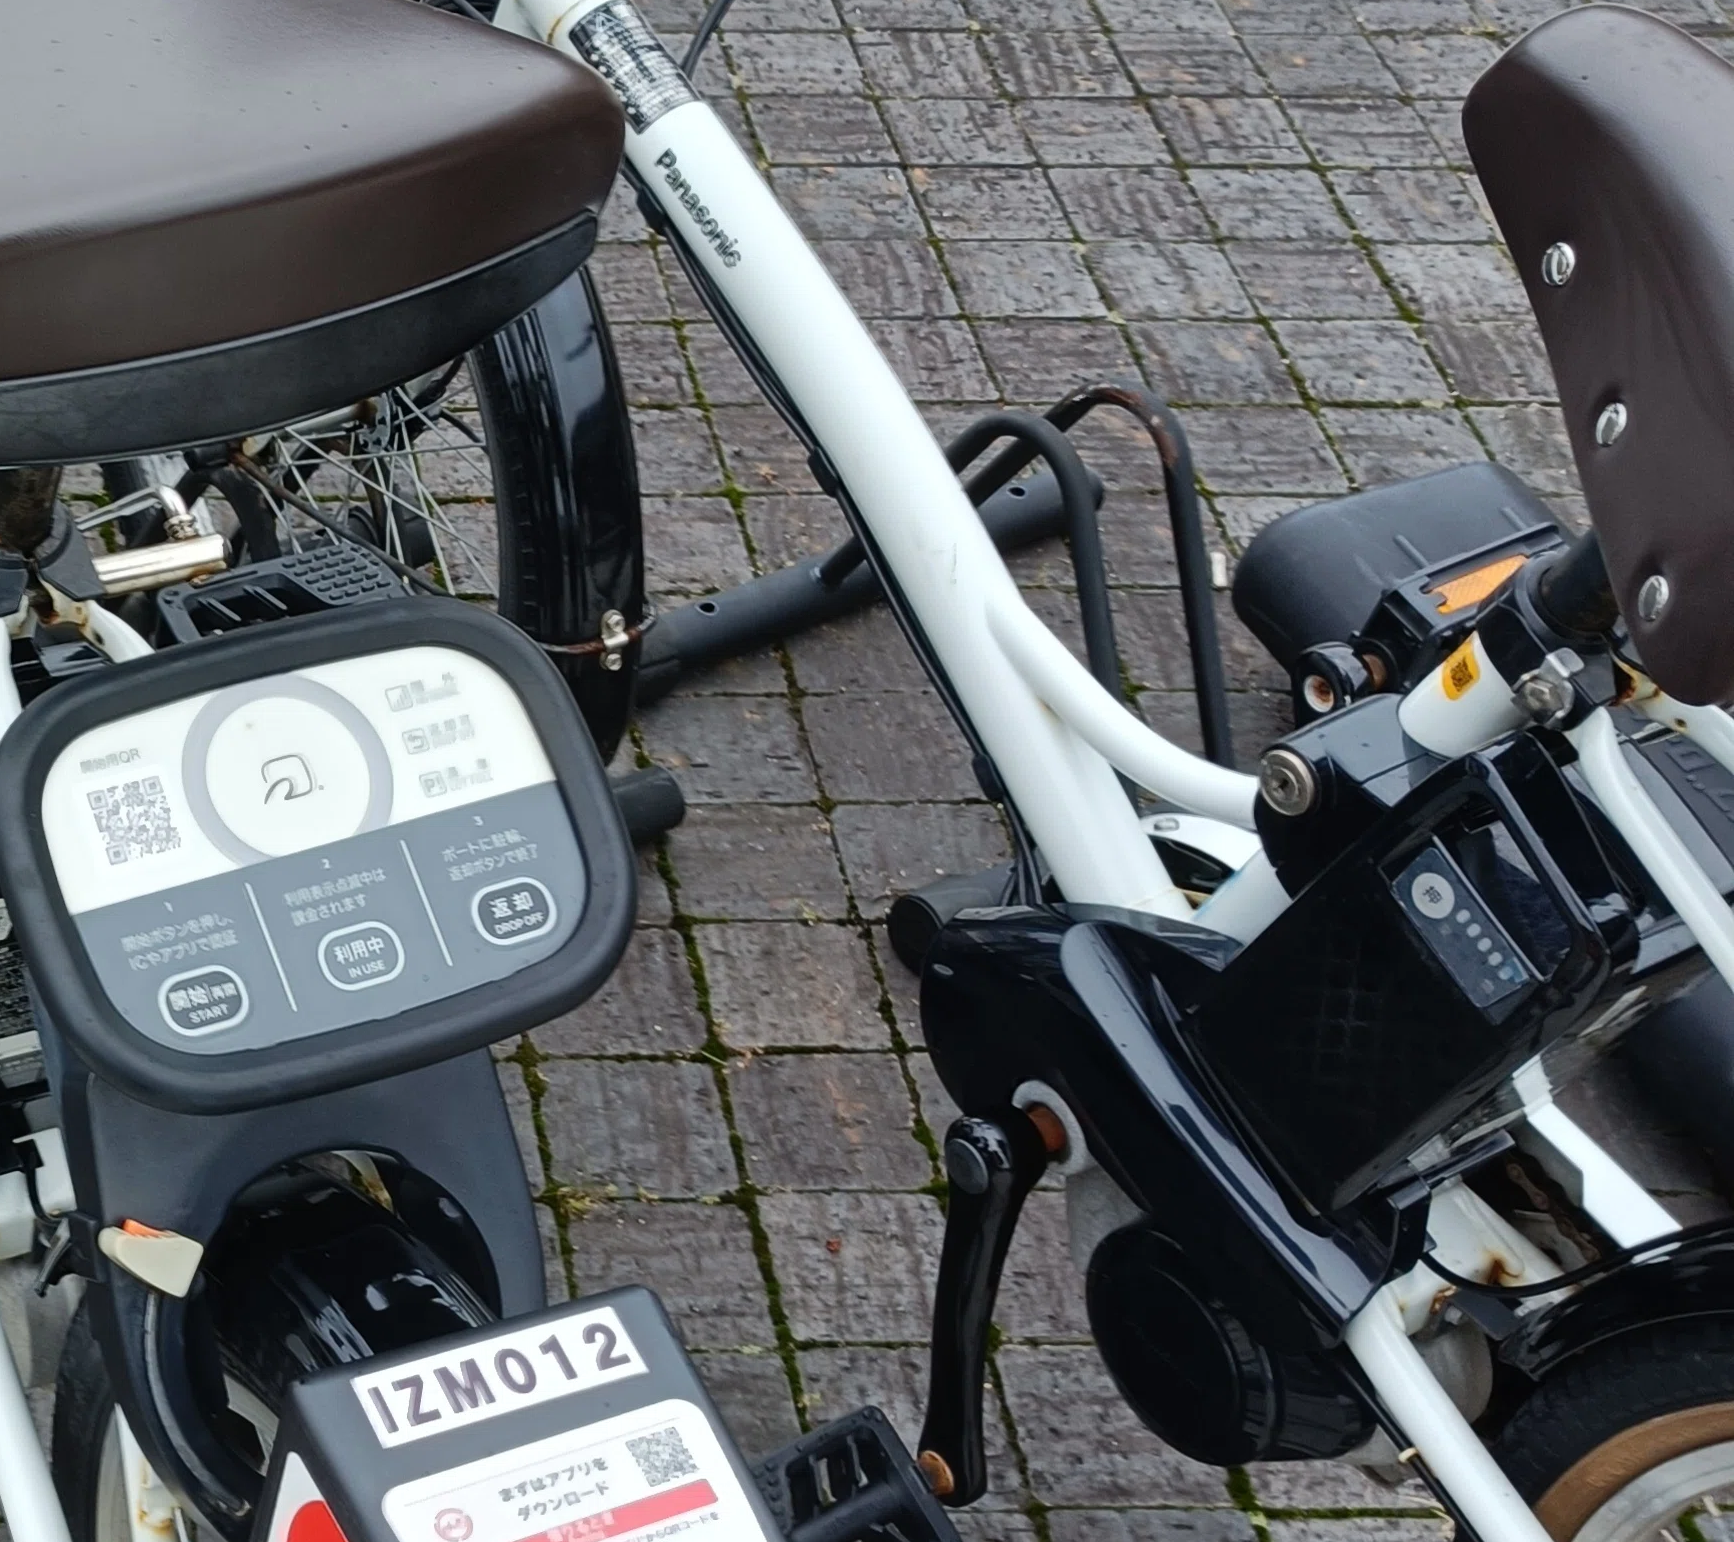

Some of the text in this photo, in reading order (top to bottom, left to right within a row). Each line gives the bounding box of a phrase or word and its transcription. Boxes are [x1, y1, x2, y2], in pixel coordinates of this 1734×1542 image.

[653, 146, 743, 270] Panasonic
[321, 858, 332, 870] 2
[487, 890, 535, 919] 返却
[493, 911, 545, 935] DROP OFF
[332, 935, 386, 965] 利用中
[347, 959, 387, 979] IN USE
[188, 1002, 229, 1024] START
[367, 1322, 633, 1434] IZM012
[497, 1456, 609, 1503] まずはアプリを
[517, 1480, 610, 1521] ダウンロード
